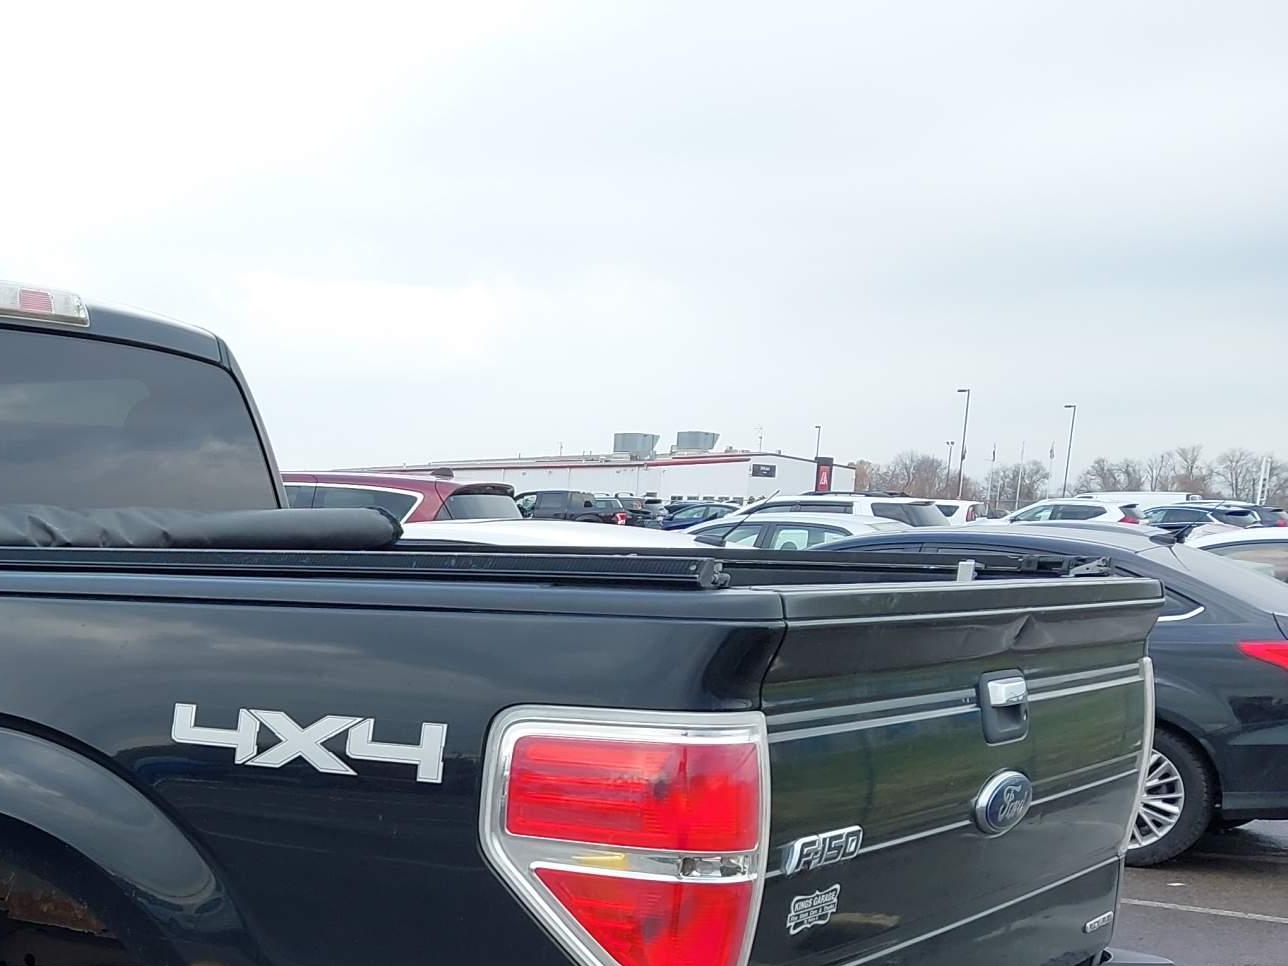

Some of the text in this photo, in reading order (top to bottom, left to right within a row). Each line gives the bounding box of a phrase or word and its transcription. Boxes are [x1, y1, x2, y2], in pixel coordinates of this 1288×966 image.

[998, 785, 1027, 822] Ford
[793, 826, 863, 873] F-150
[794, 891, 836, 912] KINGS GARAGE
